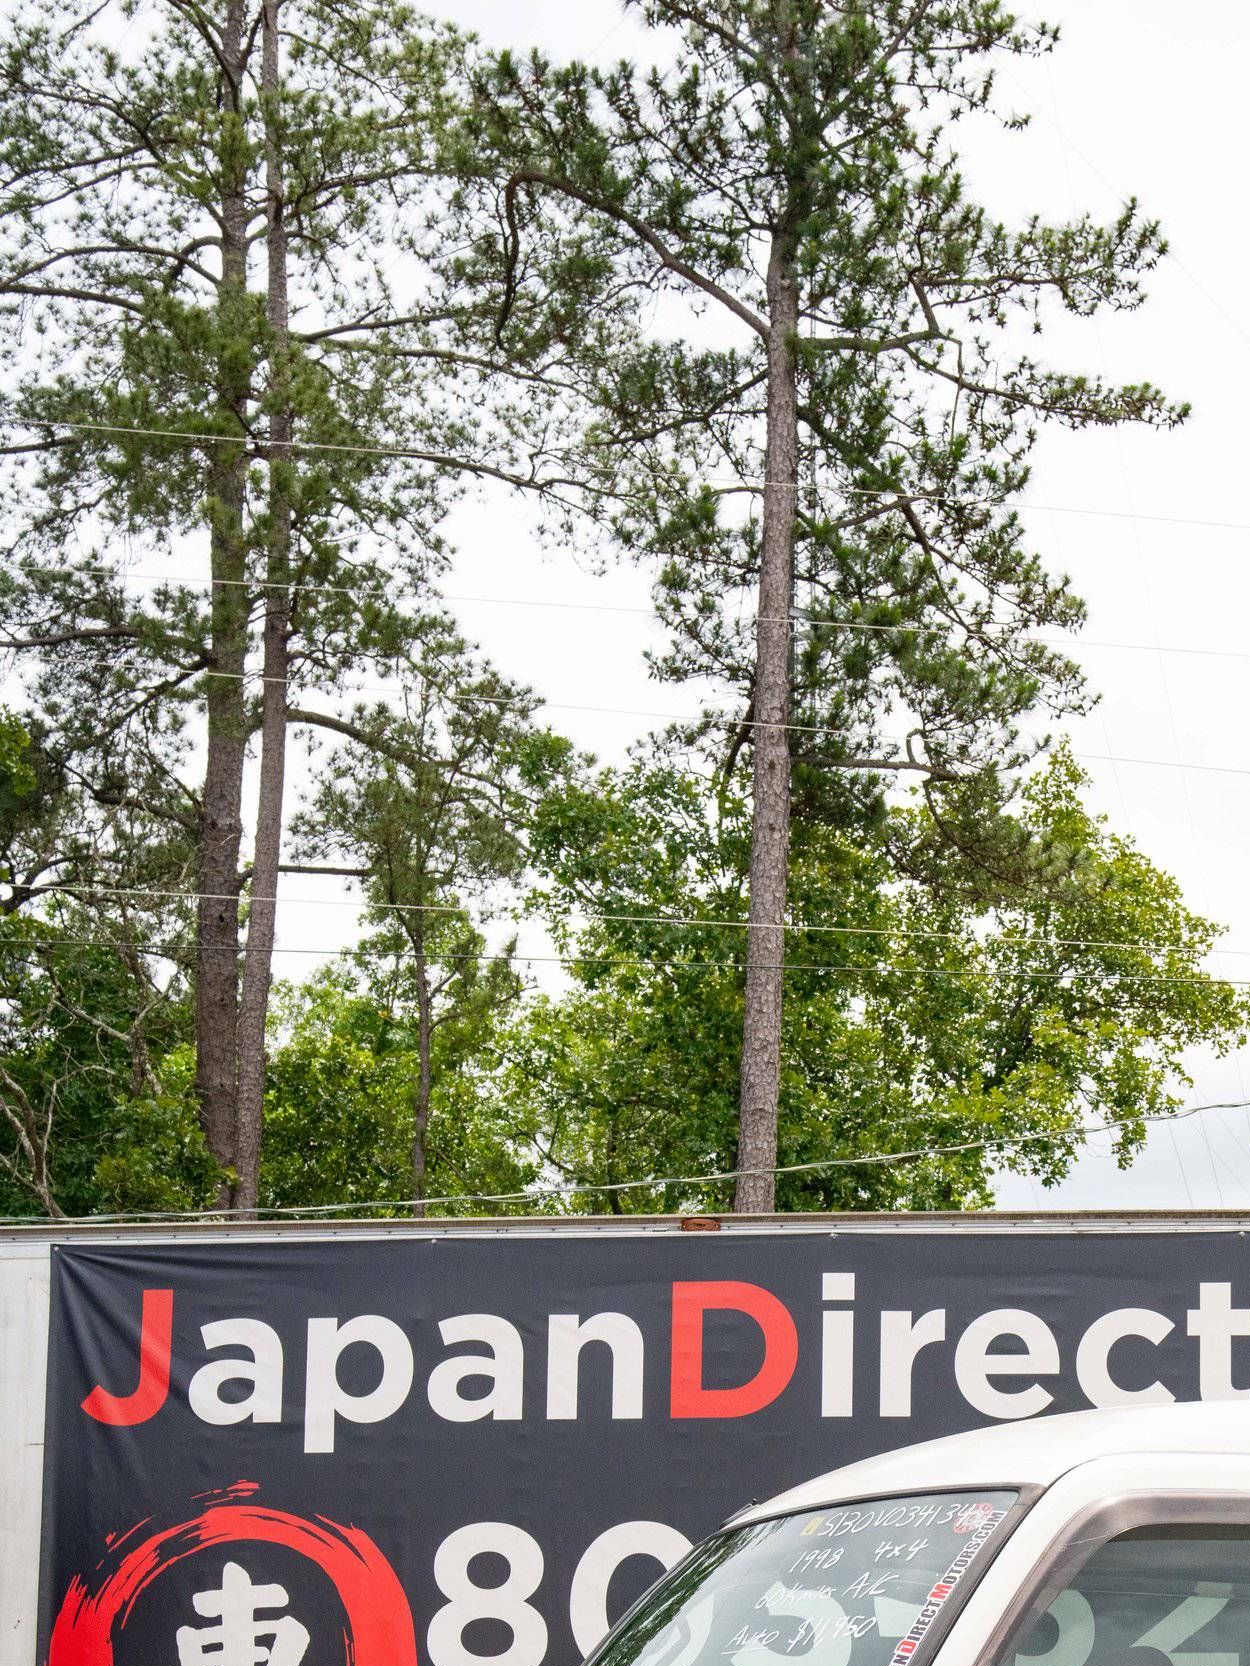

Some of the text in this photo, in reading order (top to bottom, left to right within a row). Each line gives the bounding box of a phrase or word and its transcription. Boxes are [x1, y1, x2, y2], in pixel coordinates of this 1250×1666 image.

[789, 1538, 930, 1574] 1998 4x4
[842, 1571, 899, 1600] A/C
